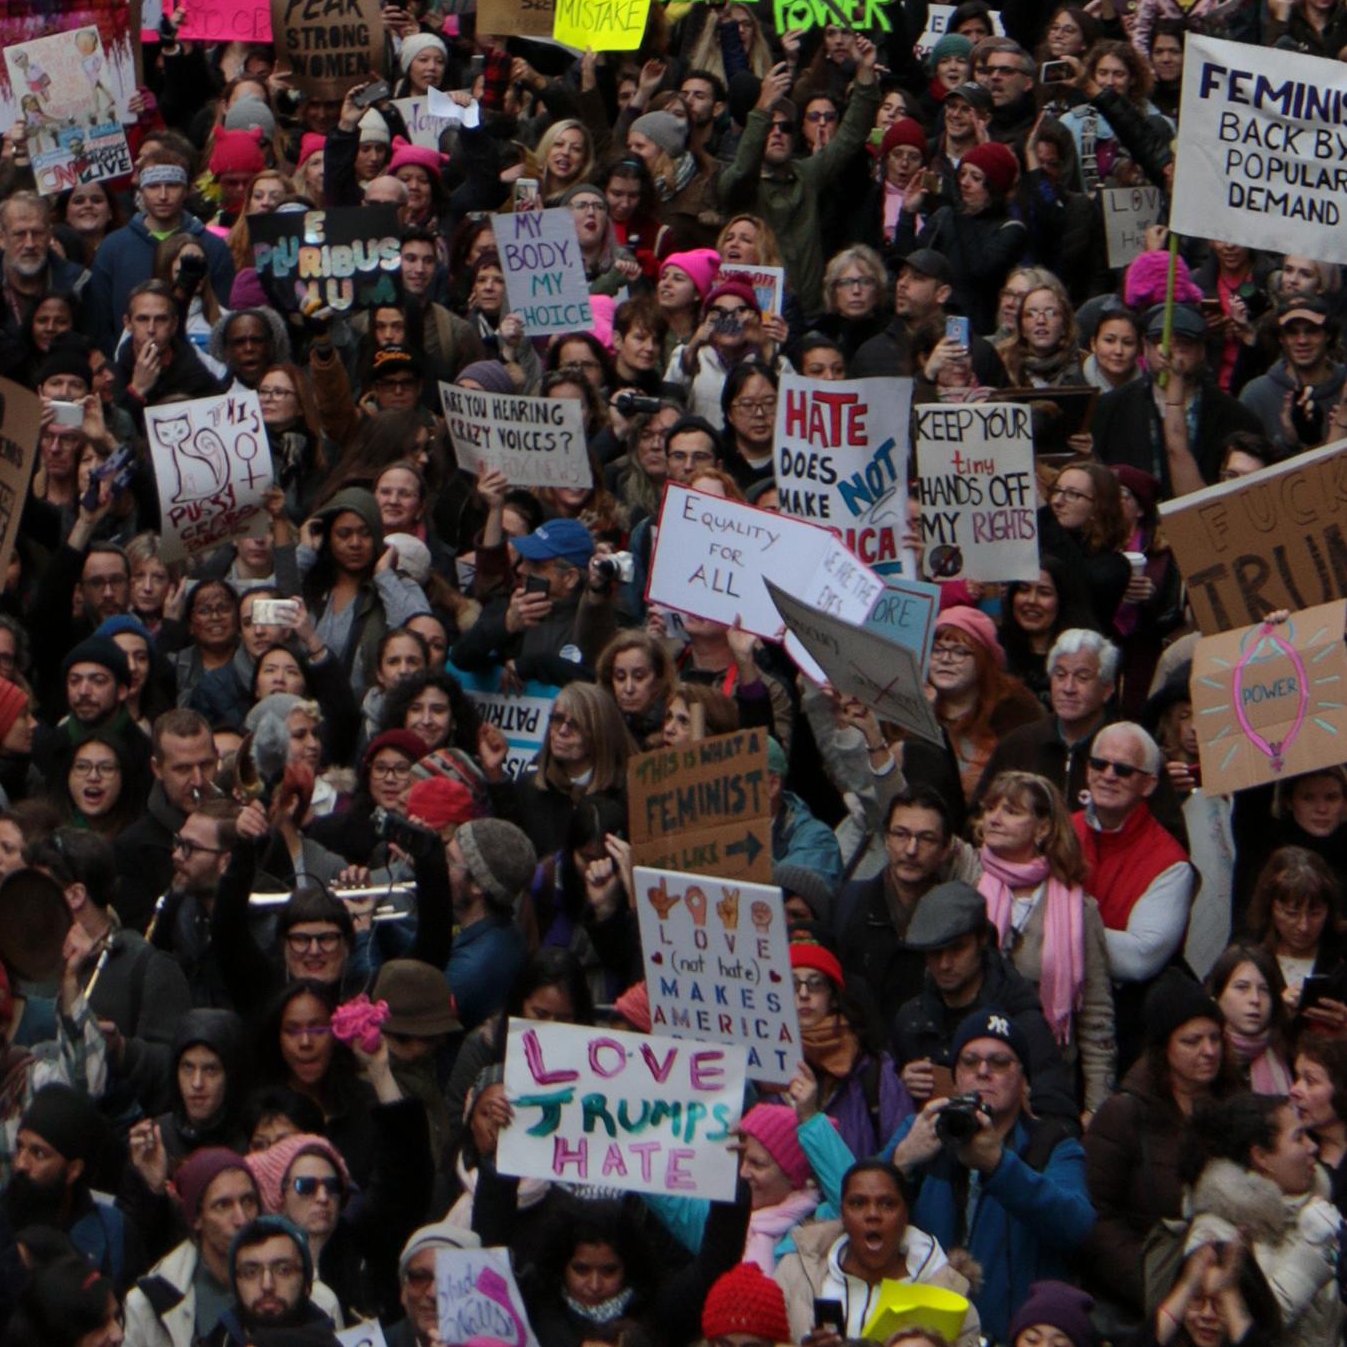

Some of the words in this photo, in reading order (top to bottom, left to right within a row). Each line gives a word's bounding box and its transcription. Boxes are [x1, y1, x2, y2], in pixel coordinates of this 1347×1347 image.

[1228, 181, 1340, 226] DEMAND
[514, 210, 544, 239] MY
[504, 241, 573, 272] BODY,
[531, 272, 564, 296] MY
[786, 388, 869, 448] HATE
[916, 408, 970, 442] KEEP
[978, 407, 1032, 440] YOUR
[780, 447, 838, 485] DOES
[837, 438, 897, 516] NOT
[951, 451, 995, 477] tiny
[778, 488, 831, 519] MAKE
[920, 475, 982, 507] HANDS
[988, 472, 1030, 507] OFF
[682, 494, 781, 553] EQUALITY
[922, 512, 961, 544] MY
[973, 509, 1036, 543] RIGHTS
[709, 542, 745, 568] FOR
[687, 566, 740, 599] ALL
[521, 1029, 727, 1091] LOVE
[515, 1085, 730, 1143] TRUMPS
[553, 1135, 697, 1191] HATE
